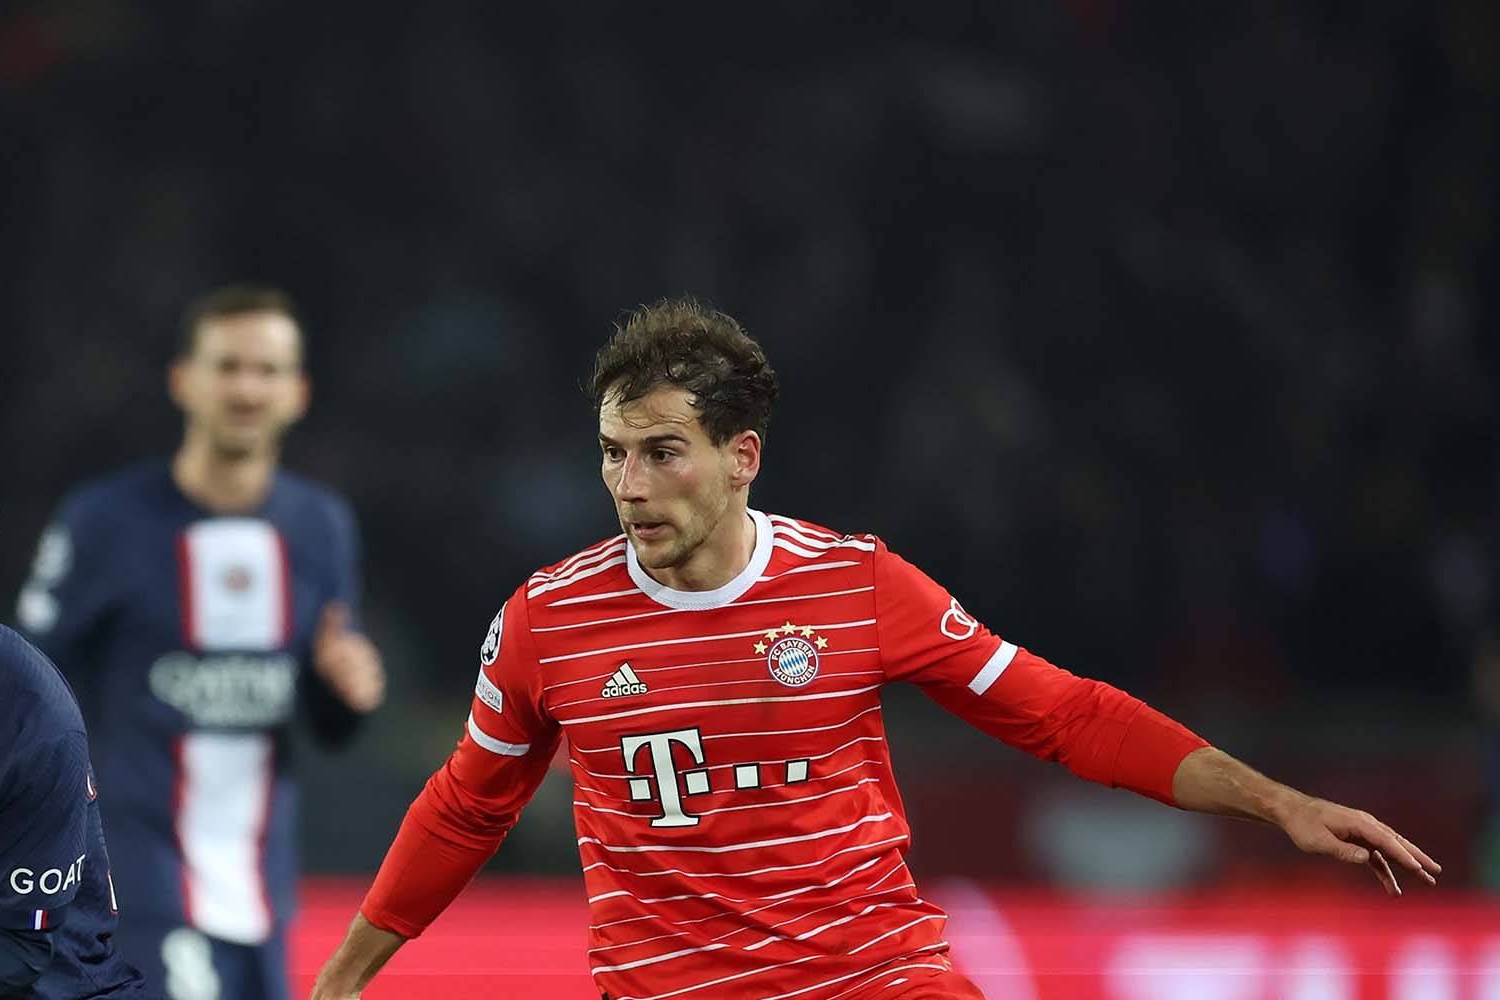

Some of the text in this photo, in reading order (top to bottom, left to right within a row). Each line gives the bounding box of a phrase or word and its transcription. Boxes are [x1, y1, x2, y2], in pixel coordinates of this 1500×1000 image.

[780, 640, 814, 658] BAYERN
[601, 683, 648, 698] adidas
[9, 854, 86, 895] GOAT
